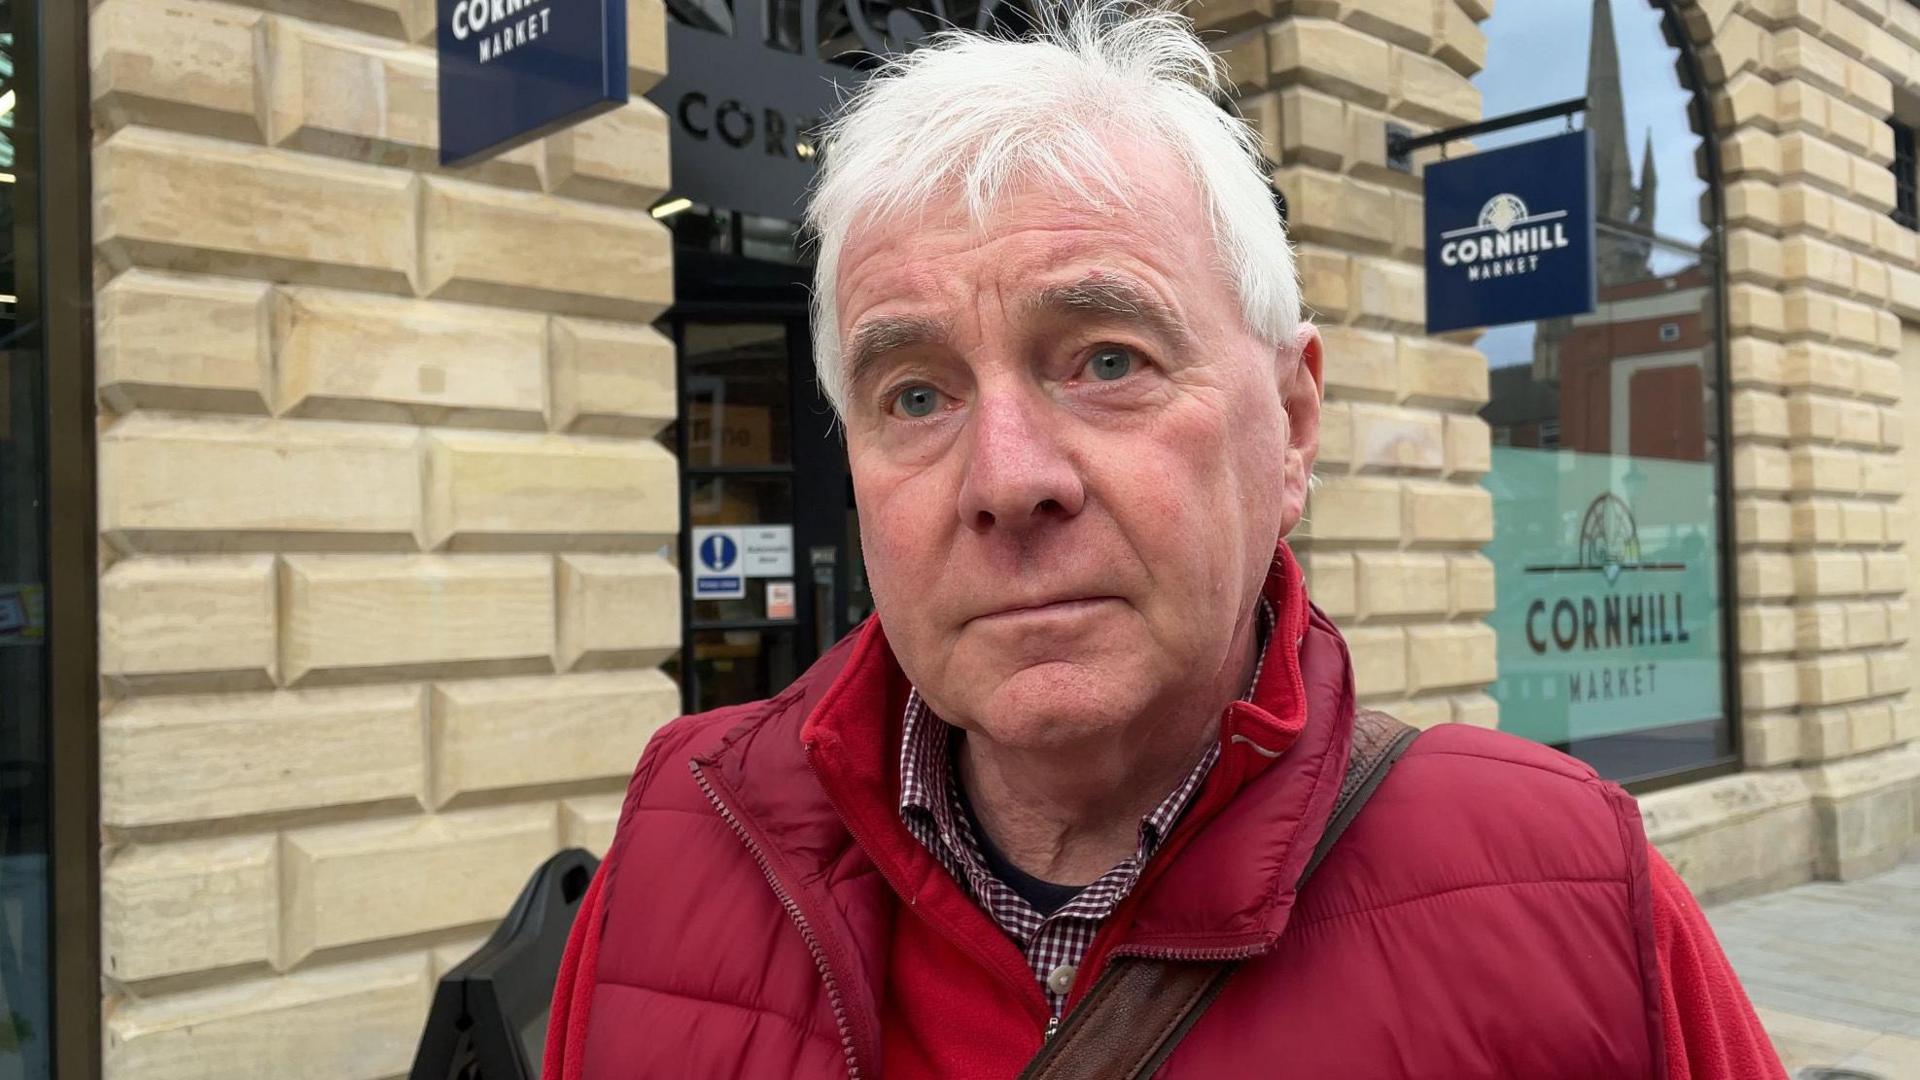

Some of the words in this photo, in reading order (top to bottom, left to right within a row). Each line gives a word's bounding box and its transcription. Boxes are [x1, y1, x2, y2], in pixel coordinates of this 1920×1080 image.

[479, 8, 551, 64] MARKET
[1441, 223, 1569, 266] CORNHILL
[1468, 255, 1538, 281] MARKET
[1525, 593, 1689, 655] CORNHILL
[1569, 664, 1656, 702] MARKET
